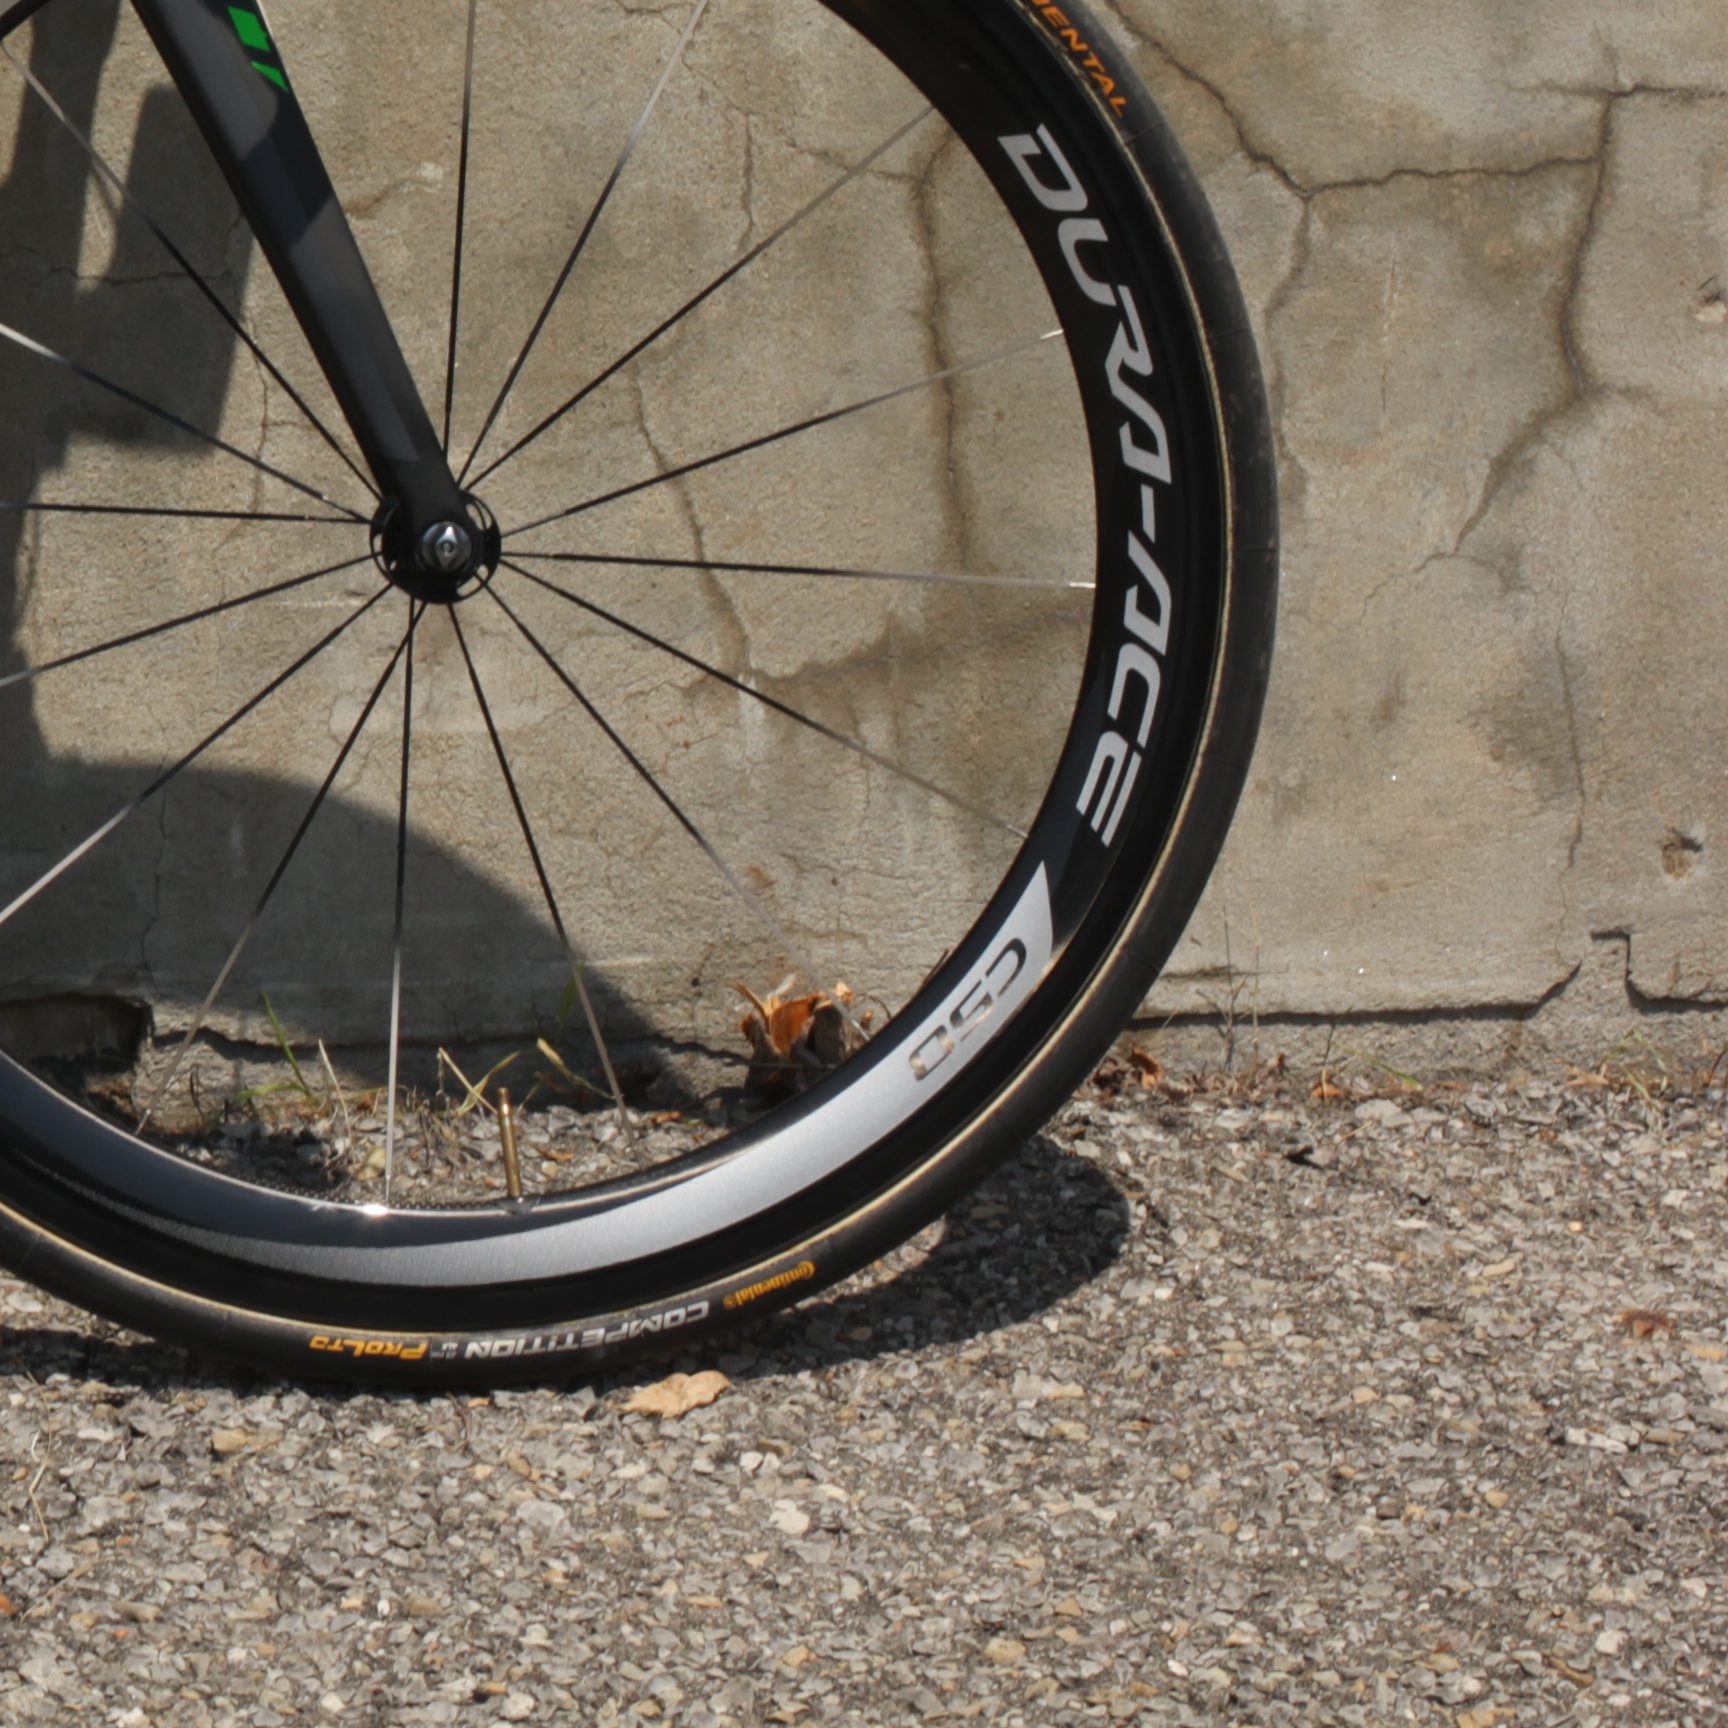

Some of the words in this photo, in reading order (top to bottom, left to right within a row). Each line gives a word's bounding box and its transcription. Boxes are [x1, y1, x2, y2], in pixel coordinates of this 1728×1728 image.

[997, 122, 1173, 847] DURA-ACE
[908, 938, 1027, 1081] C50
[464, 1300, 709, 1360] COMPETITION
